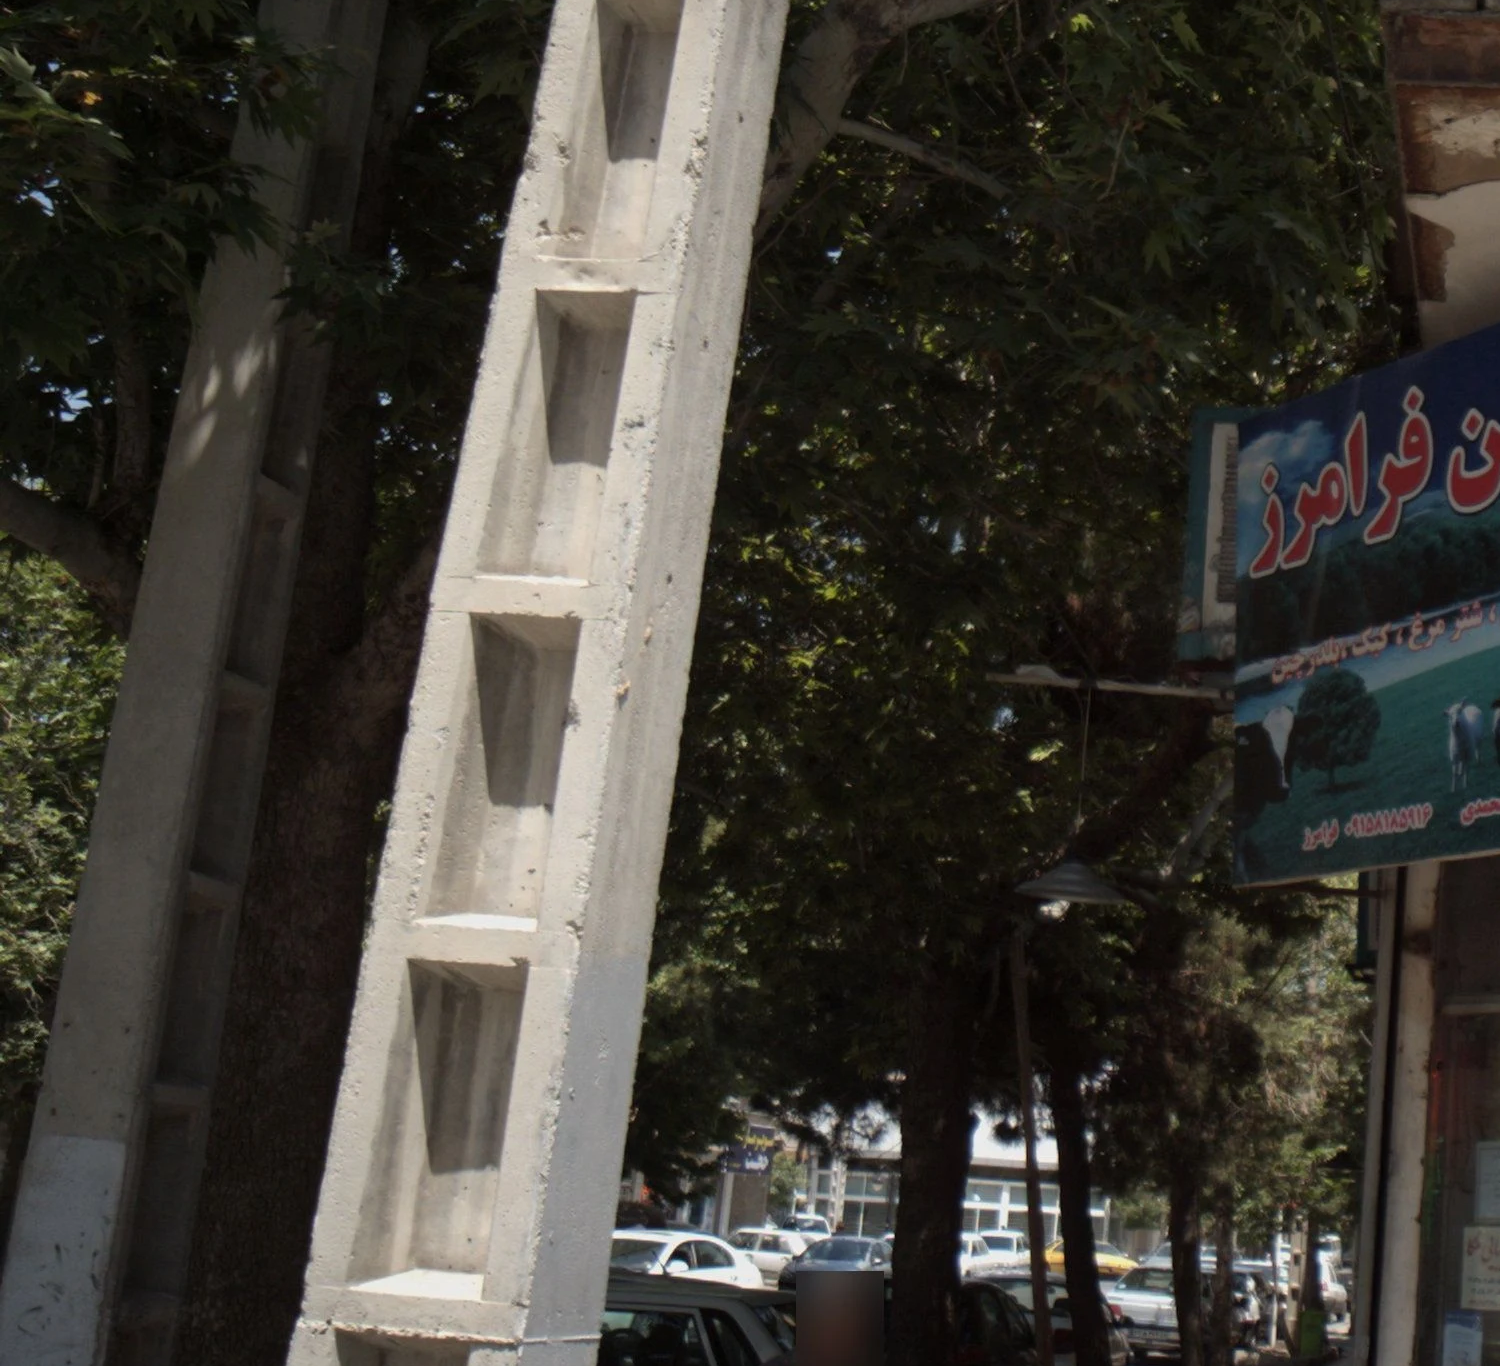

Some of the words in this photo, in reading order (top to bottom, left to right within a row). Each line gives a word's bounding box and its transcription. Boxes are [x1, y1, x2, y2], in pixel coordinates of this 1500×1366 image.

[1248, 387, 1435, 579] فرامرز
[1351, 621, 1393, 658] کبک
[1406, 611, 1446, 652] مرغ
[1449, 600, 1484, 642] شتر
[1302, 817, 1340, 851] فرامرز
